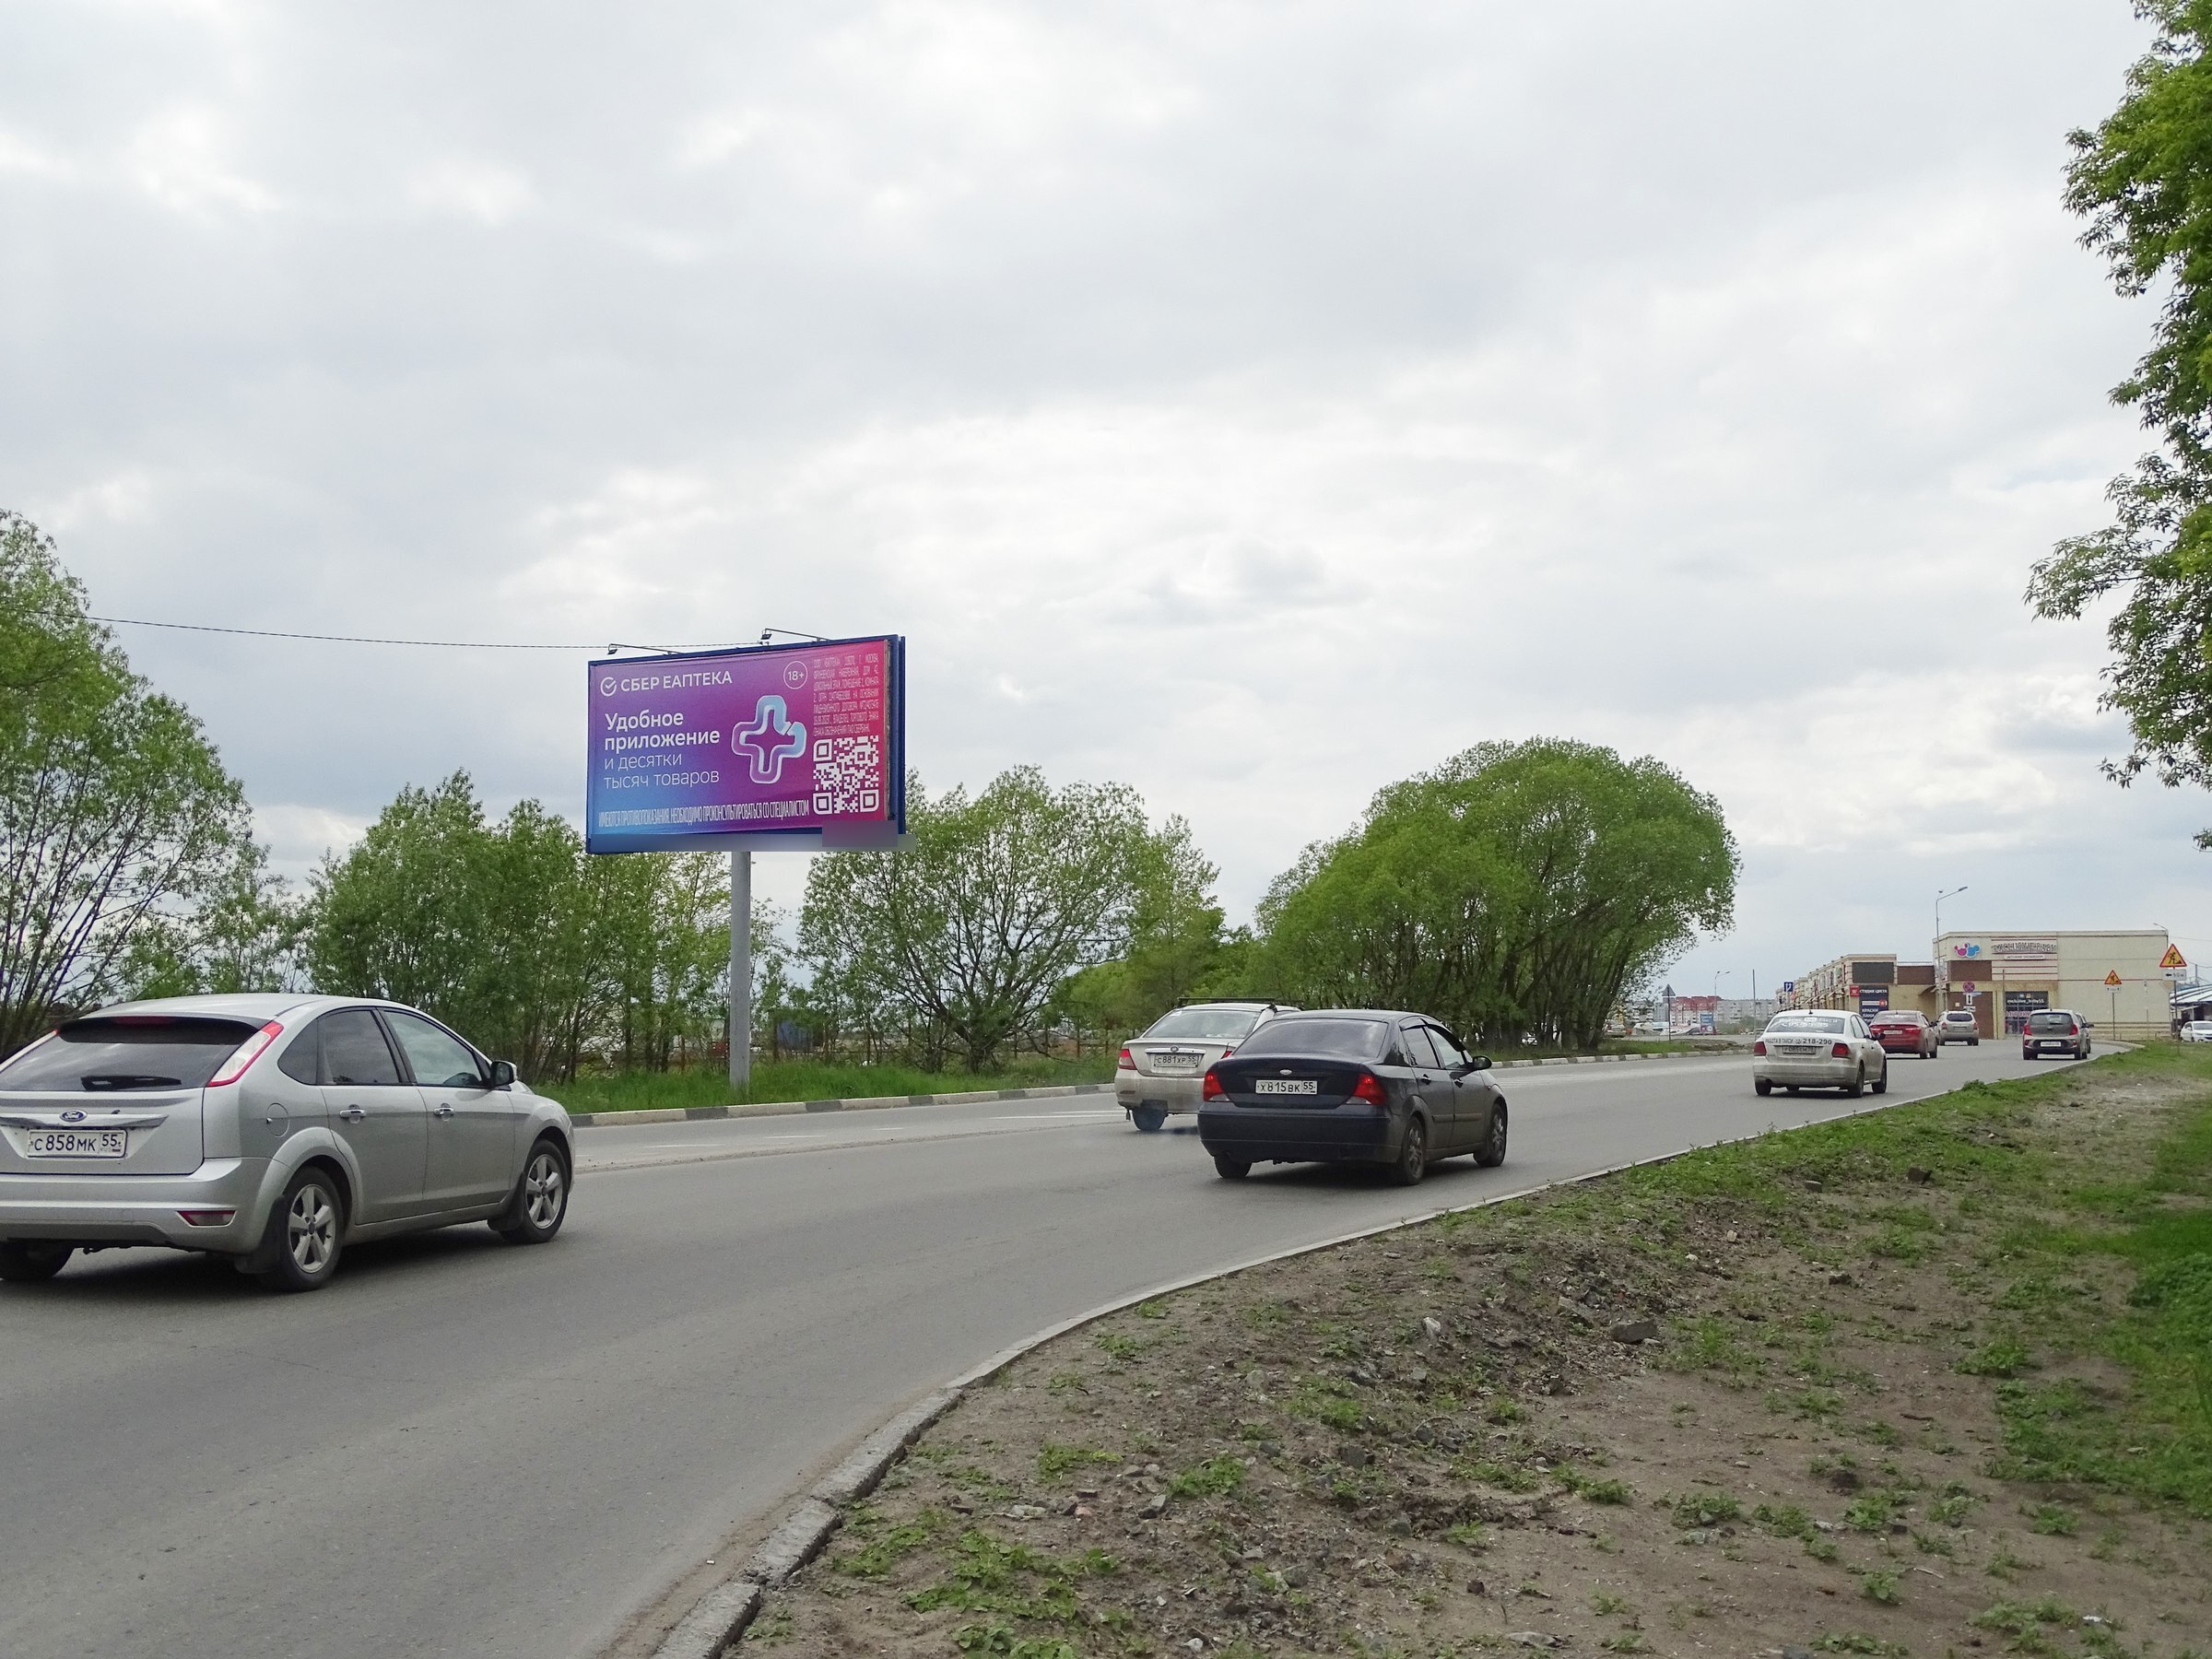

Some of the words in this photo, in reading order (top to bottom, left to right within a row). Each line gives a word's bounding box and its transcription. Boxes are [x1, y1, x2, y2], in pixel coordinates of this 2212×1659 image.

[620, 677, 660, 692] СБЕР
[663, 670, 733, 689] ЕАПТЕКА
[787, 671, 805, 681] 18+
[604, 709, 684, 733] Удобное
[604, 729, 721, 755] приложение
[604, 758, 614, 770] и
[618, 753, 683, 772] десятки
[604, 773, 649, 790] тысяч
[653, 770, 720, 788] товаров
[770, 799, 810, 821] СПЕЦИАЛИСТОМ
[1260, 1081, 1300, 1093] Х815ВК
[1302, 1081, 1314, 1090] 55
[34, 1135, 97, 1151] С858МК
[101, 1134, 118, 1147] 55
